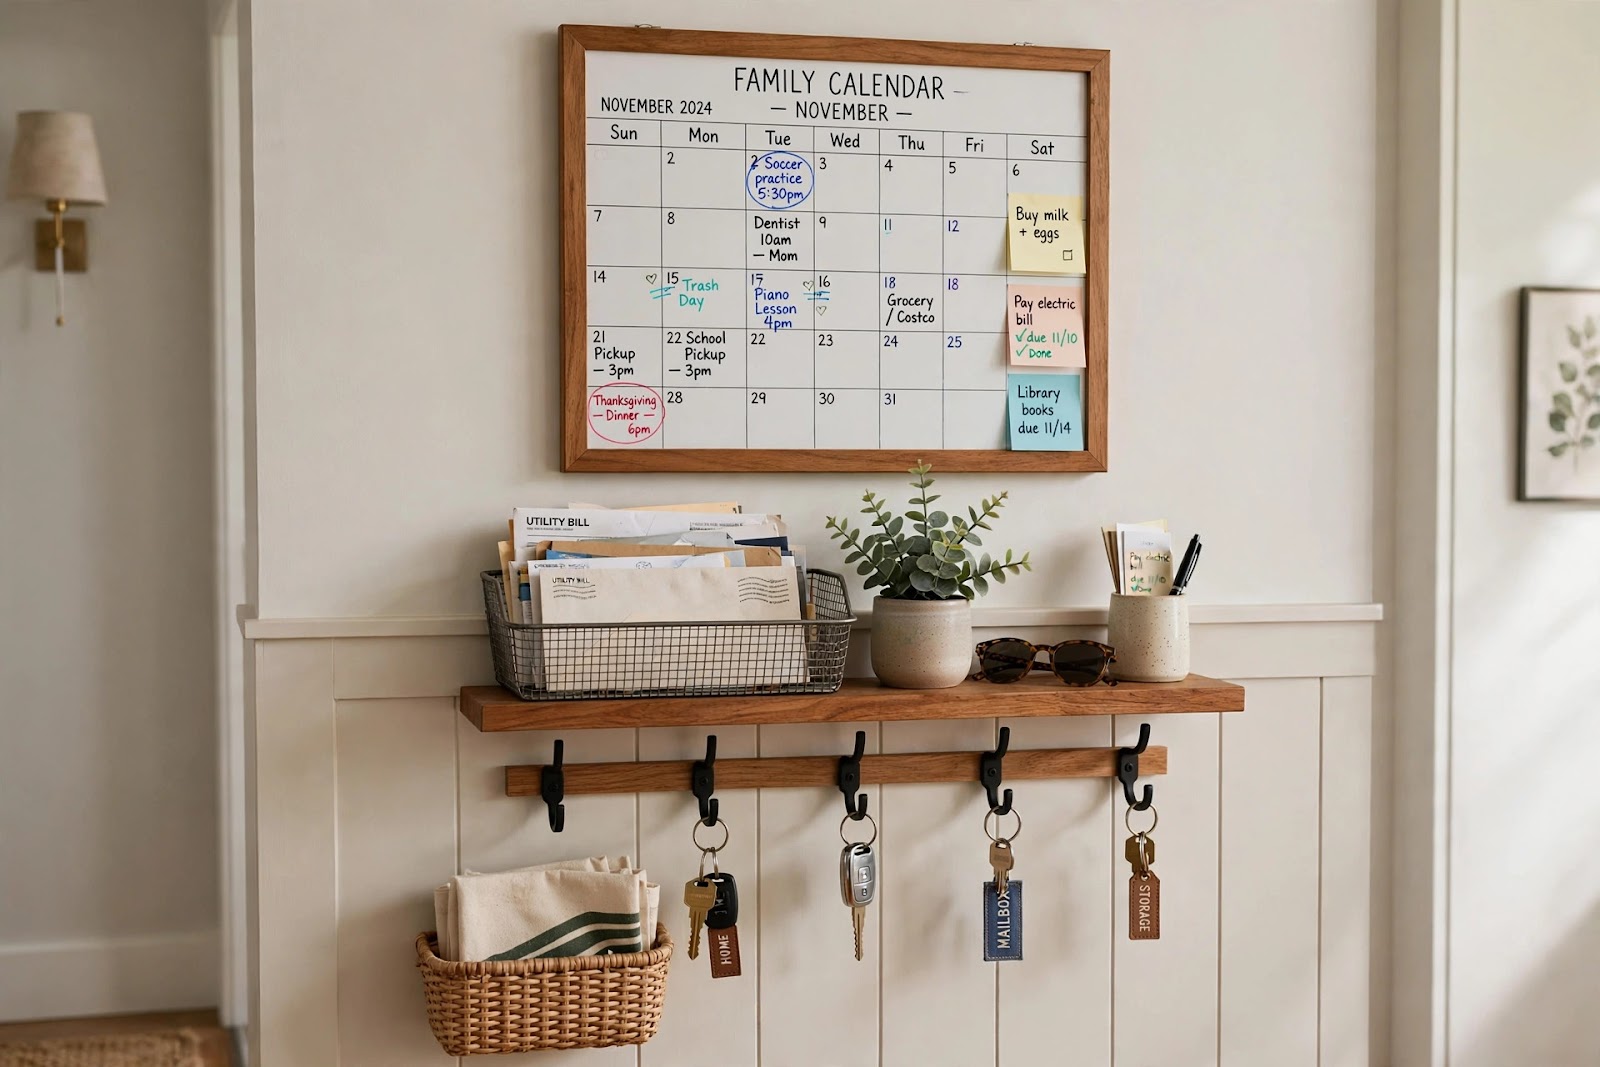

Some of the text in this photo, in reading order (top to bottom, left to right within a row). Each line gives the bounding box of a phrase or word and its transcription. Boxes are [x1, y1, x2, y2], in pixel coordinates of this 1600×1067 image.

[735, 67, 944, 100] FAMILY CALENDAR
[601, 97, 712, 116] NOVEMBER 2024
[796, 101, 889, 122] NOVEMBER
[610, 124, 1055, 155] Sun Mon Tue Wed Thu Fri Sat
[667, 152, 675, 164] 2
[752, 154, 758, 168] 2
[765, 156, 802, 170] Soccer
[819, 157, 827, 170] 3
[884, 159, 893, 172] 4
[949, 161, 957, 174] 5
[1012, 164, 1020, 176] 6
[756, 172, 802, 188] practice
[758, 187, 804, 204] 5:30pm
[594, 210, 601, 222] 7
[667, 212, 675, 224] 8
[1016, 206, 1069, 226] Buy milk
[754, 216, 801, 230] Dentist
[819, 217, 827, 229] 9
[884, 218, 892, 231] 11
[947, 220, 960, 232] 12
[761, 233, 792, 246] 10am
[1034, 229, 1060, 244] eggs
[769, 250, 798, 262] Mom
[594, 270, 607, 283] 14
[667, 272, 679, 284] 15
[818, 275, 831, 288] 16
[884, 276, 896, 289] 18
[682, 278, 719, 291] Trash
[947, 278, 959, 290] 18
[755, 288, 790, 300] Piano
[679, 294, 705, 312] Day
[755, 302, 797, 316] Lesson
[887, 294, 934, 311] Grocery
[1014, 295, 1076, 312] Pay electric
[764, 316, 792, 332] 4pm
[897, 311, 935, 324] Costco
[1016, 313, 1033, 326] bill
[593, 331, 605, 343] 21
[666, 332, 682, 344] 22
[686, 331, 726, 344] School
[750, 333, 766, 346] 22
[818, 334, 834, 346] 23
[884, 335, 898, 348] 24
[947, 336, 962, 348] 25
[1027, 329, 1078, 346] due 11/10
[594, 347, 636, 364] Pickup
[685, 347, 726, 364] Pickup
[1028, 348, 1052, 358] Done
[608, 364, 634, 380] 3pm
[686, 364, 712, 380] 3pm
[667, 392, 683, 404] 28
[751, 392, 766, 404] 29
[818, 392, 834, 404] 30
[884, 393, 896, 406] 31
[1018, 385, 1061, 404] Library
[593, 394, 657, 410] Thanksgiving
[606, 410, 640, 421] Dinner
[1021, 402, 1054, 416] books
[628, 423, 651, 437] 6pm
[1018, 420, 1072, 438] due 11/14
[526, 516, 590, 527] UTILITY BILL
[1139, 885, 1150, 932] STORAGE
[997, 890, 1010, 949] MAILBOX
[718, 934, 732, 965] HOME
